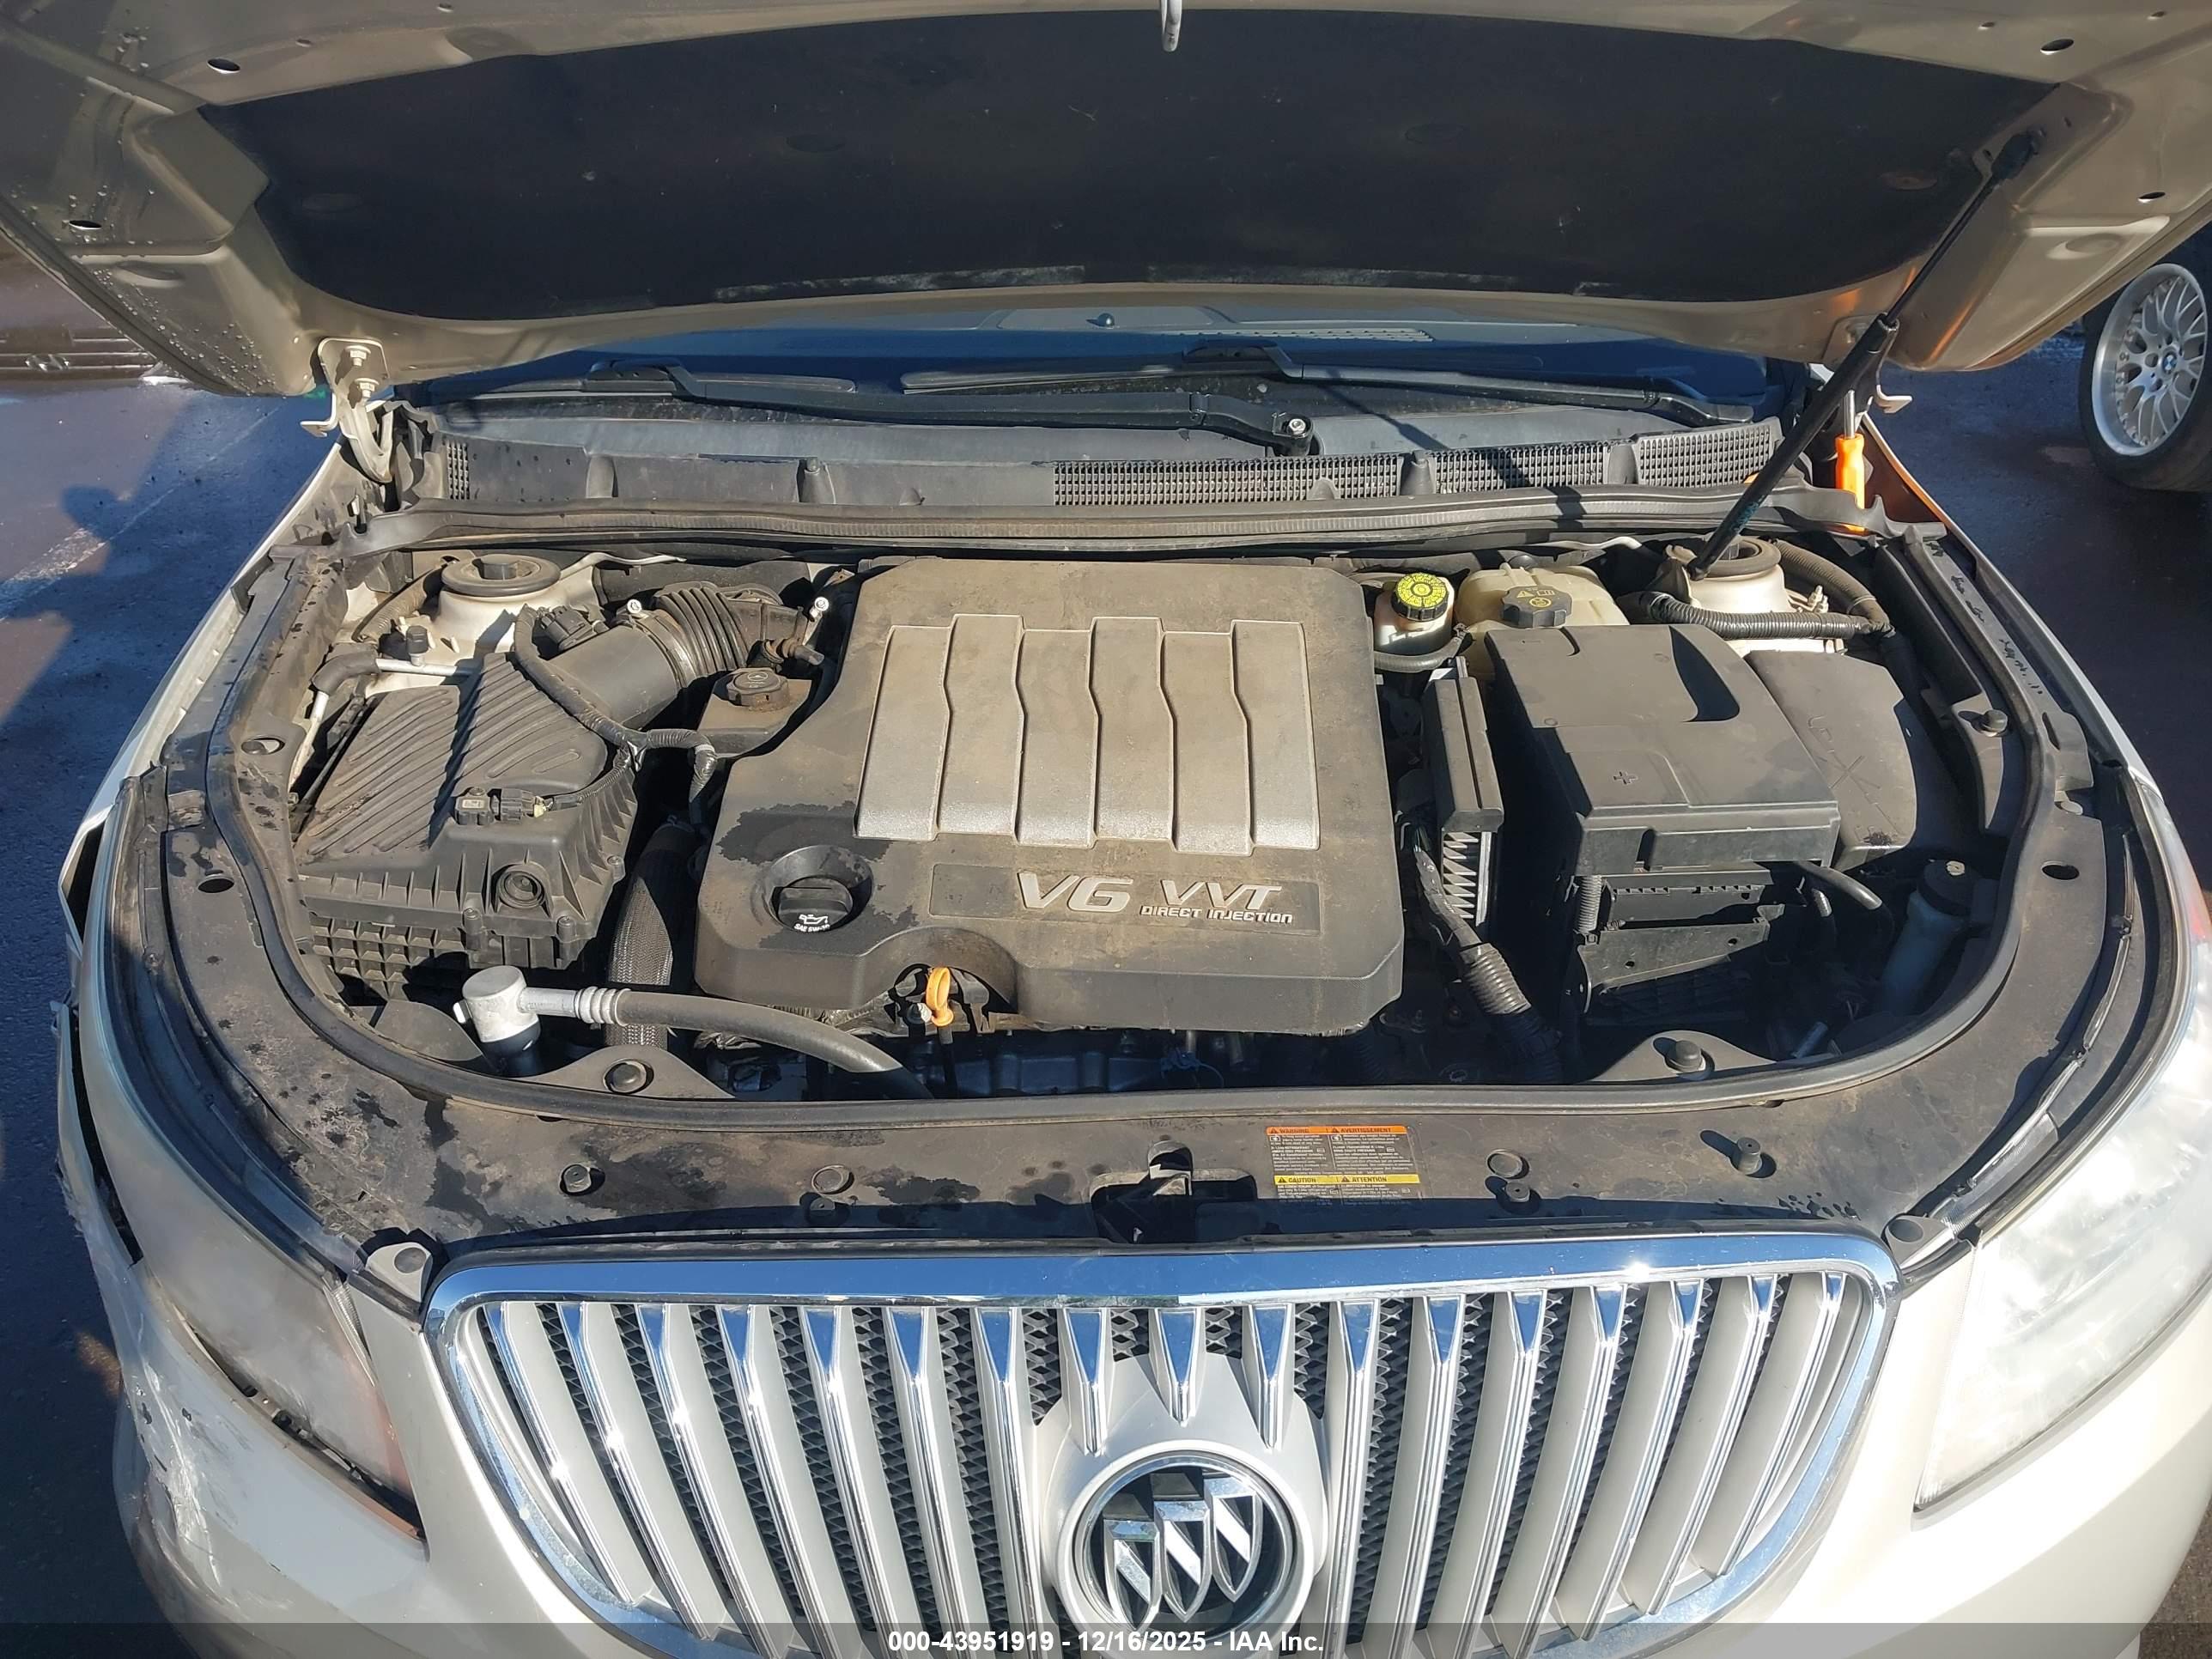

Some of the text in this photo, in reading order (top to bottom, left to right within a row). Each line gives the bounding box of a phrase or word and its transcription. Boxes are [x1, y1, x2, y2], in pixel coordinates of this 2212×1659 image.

[1018, 872, 1282, 912] V6 VVT
[1140, 905, 1292, 924] DIRECT INJECTION
